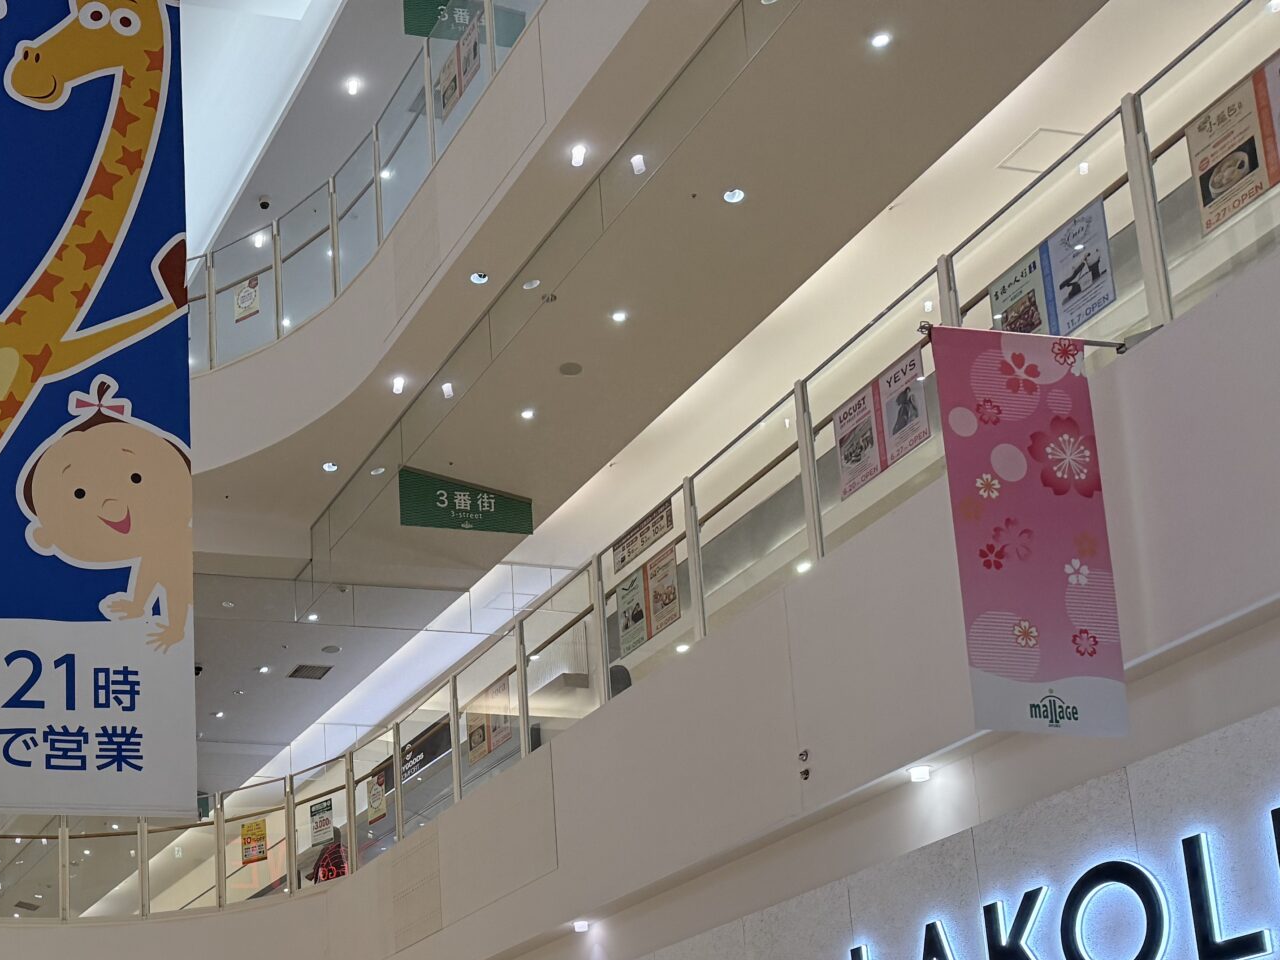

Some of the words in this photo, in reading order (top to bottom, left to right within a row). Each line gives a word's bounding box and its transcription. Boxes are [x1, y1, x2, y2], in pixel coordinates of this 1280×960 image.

[1232, 181, 1264, 210] OPEN
[1085, 293, 1110, 316] OPEN
[886, 359, 916, 388] YEVS
[839, 396, 866, 424] LOCUST
[908, 427, 928, 447] OPEN
[860, 466, 879, 482] OPEN
[436, 490, 495, 512] 3番街
